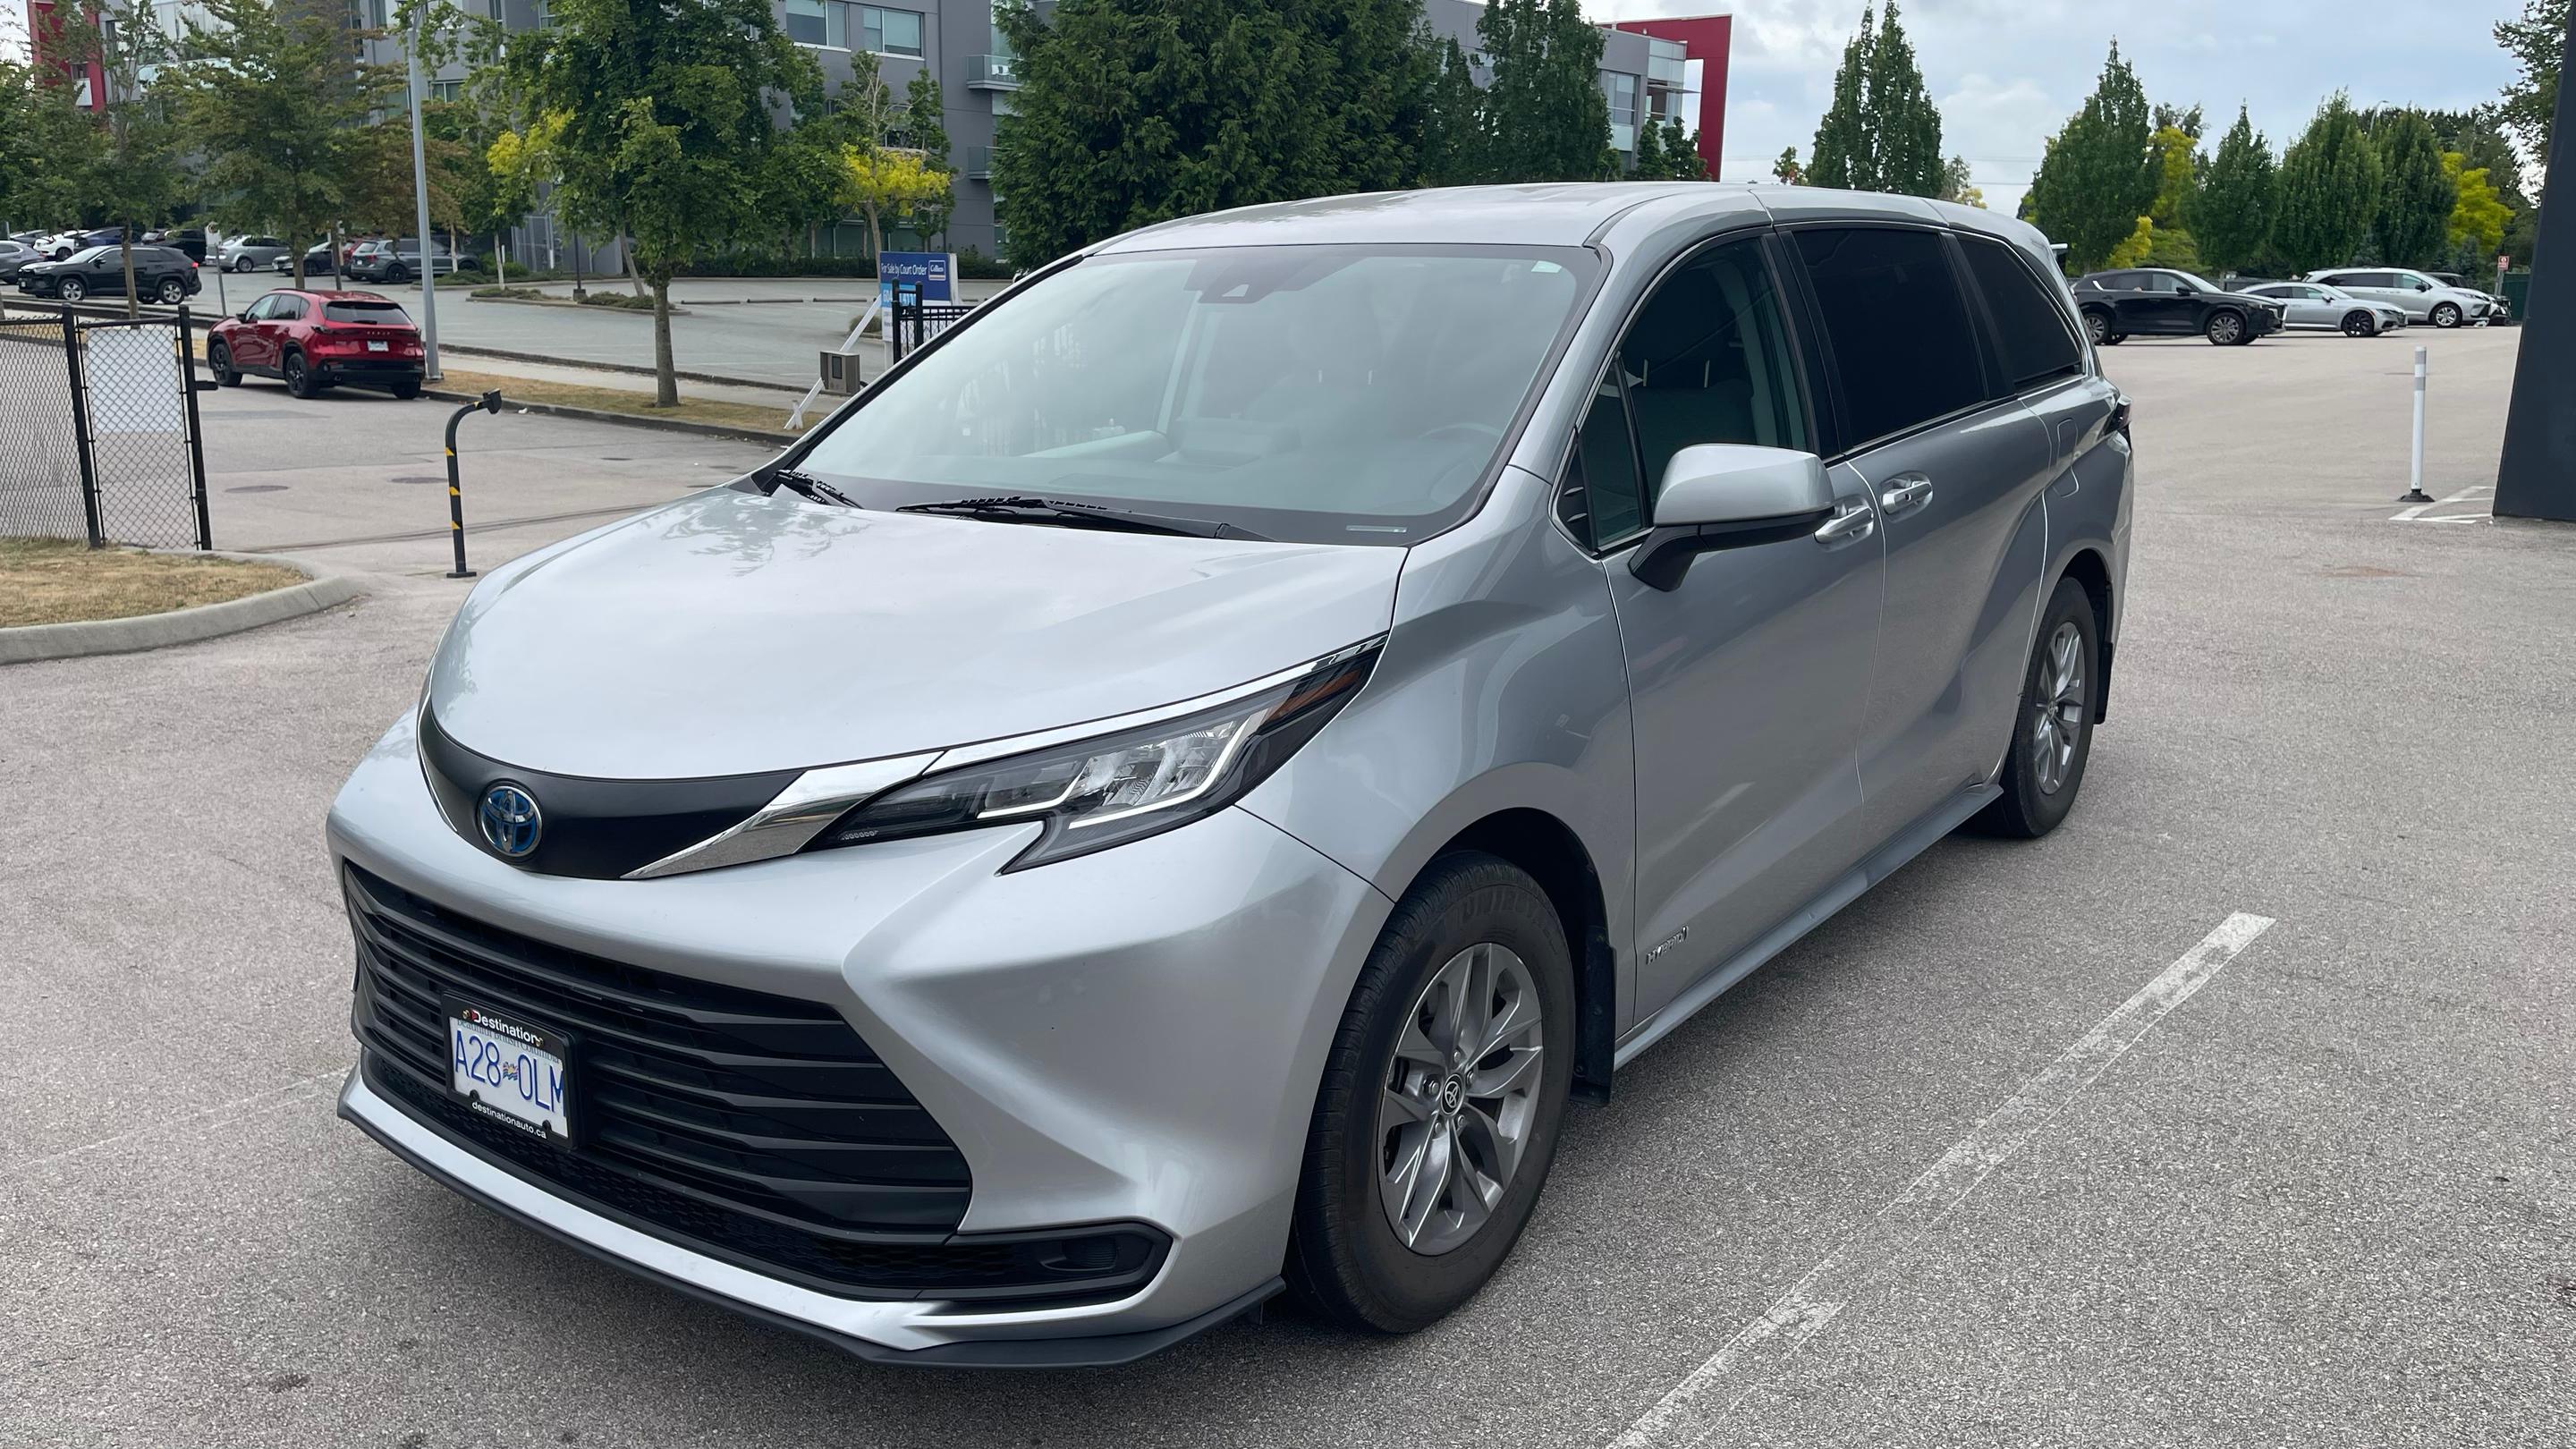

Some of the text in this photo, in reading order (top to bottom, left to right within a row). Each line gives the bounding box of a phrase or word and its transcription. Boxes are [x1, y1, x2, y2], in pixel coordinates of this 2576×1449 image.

[900, 264, 911, 275] Court
[912, 264, 928, 275] Order
[472, 1009, 541, 1046] Destination
[455, 1030, 501, 1088] A28
[471, 1101, 547, 1140] destinationauto.ca
